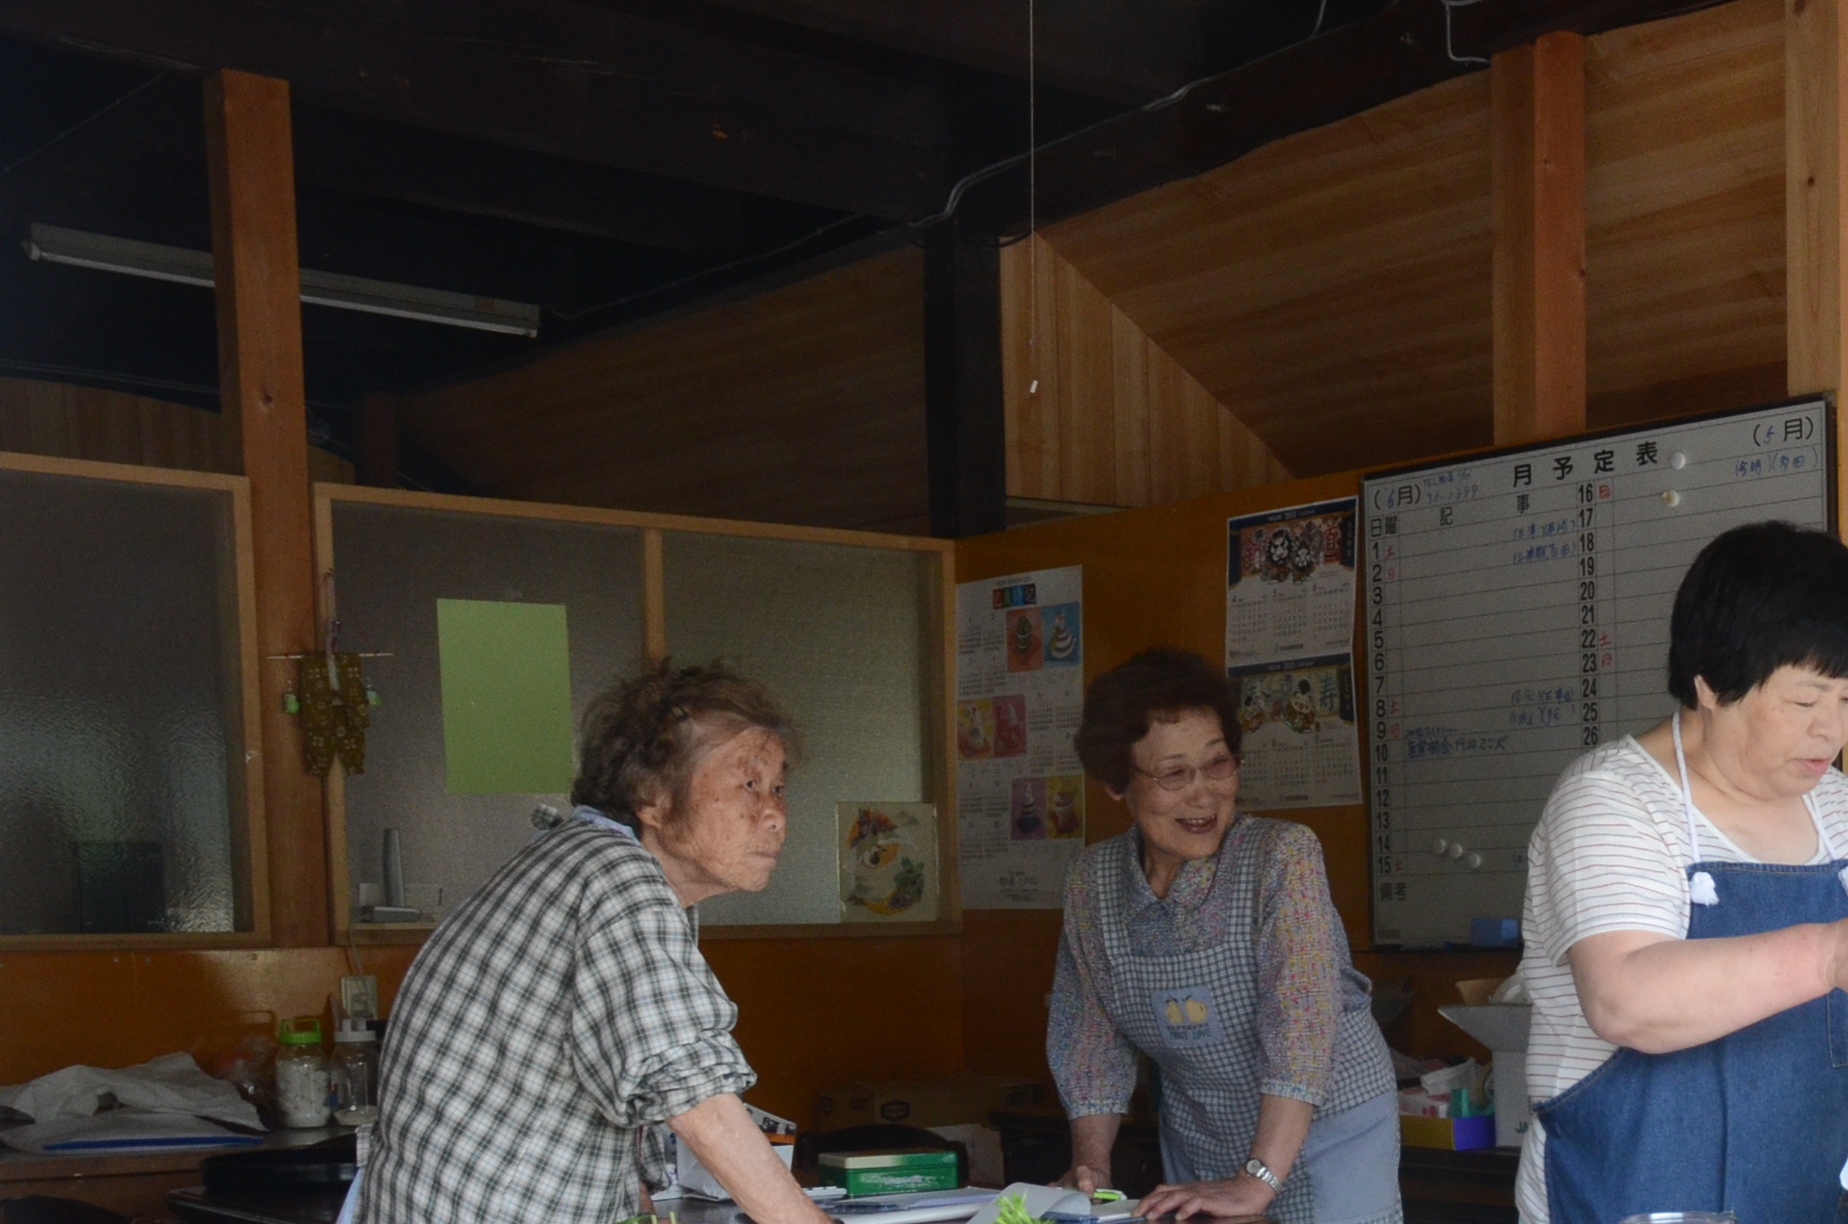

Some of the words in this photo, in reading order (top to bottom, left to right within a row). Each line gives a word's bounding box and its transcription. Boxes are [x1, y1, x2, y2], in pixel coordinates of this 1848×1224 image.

[1513, 441, 1659, 488] 月予定表
[1579, 484, 1593, 504] 16
[1579, 508, 1593, 528] 17
[1373, 542, 1380, 560] 1
[1579, 532, 1594, 552] 18
[1372, 565, 1382, 582] 2
[1580, 556, 1594, 576] 19
[1373, 586, 1383, 605] 3
[1580, 581, 1595, 601] 20
[1373, 609, 1383, 626] 4
[1581, 605, 1595, 624] 21
[1373, 631, 1384, 648] 5
[1581, 629, 1596, 649] 22
[1374, 653, 1384, 671] 6
[1582, 653, 1597, 673] 23
[1374, 676, 1385, 694] 7
[1582, 678, 1597, 698] 24
[1375, 699, 1385, 716] 8
[1582, 702, 1598, 722] 25
[1375, 721, 1386, 739] 9
[1583, 727, 1598, 746] 26
[1375, 744, 1388, 763] 10
[1375, 766, 1388, 784] 11
[1376, 789, 1389, 807] 12
[1376, 811, 1389, 829] 13
[1377, 834, 1390, 852] 14
[1378, 856, 1391, 874] 15
